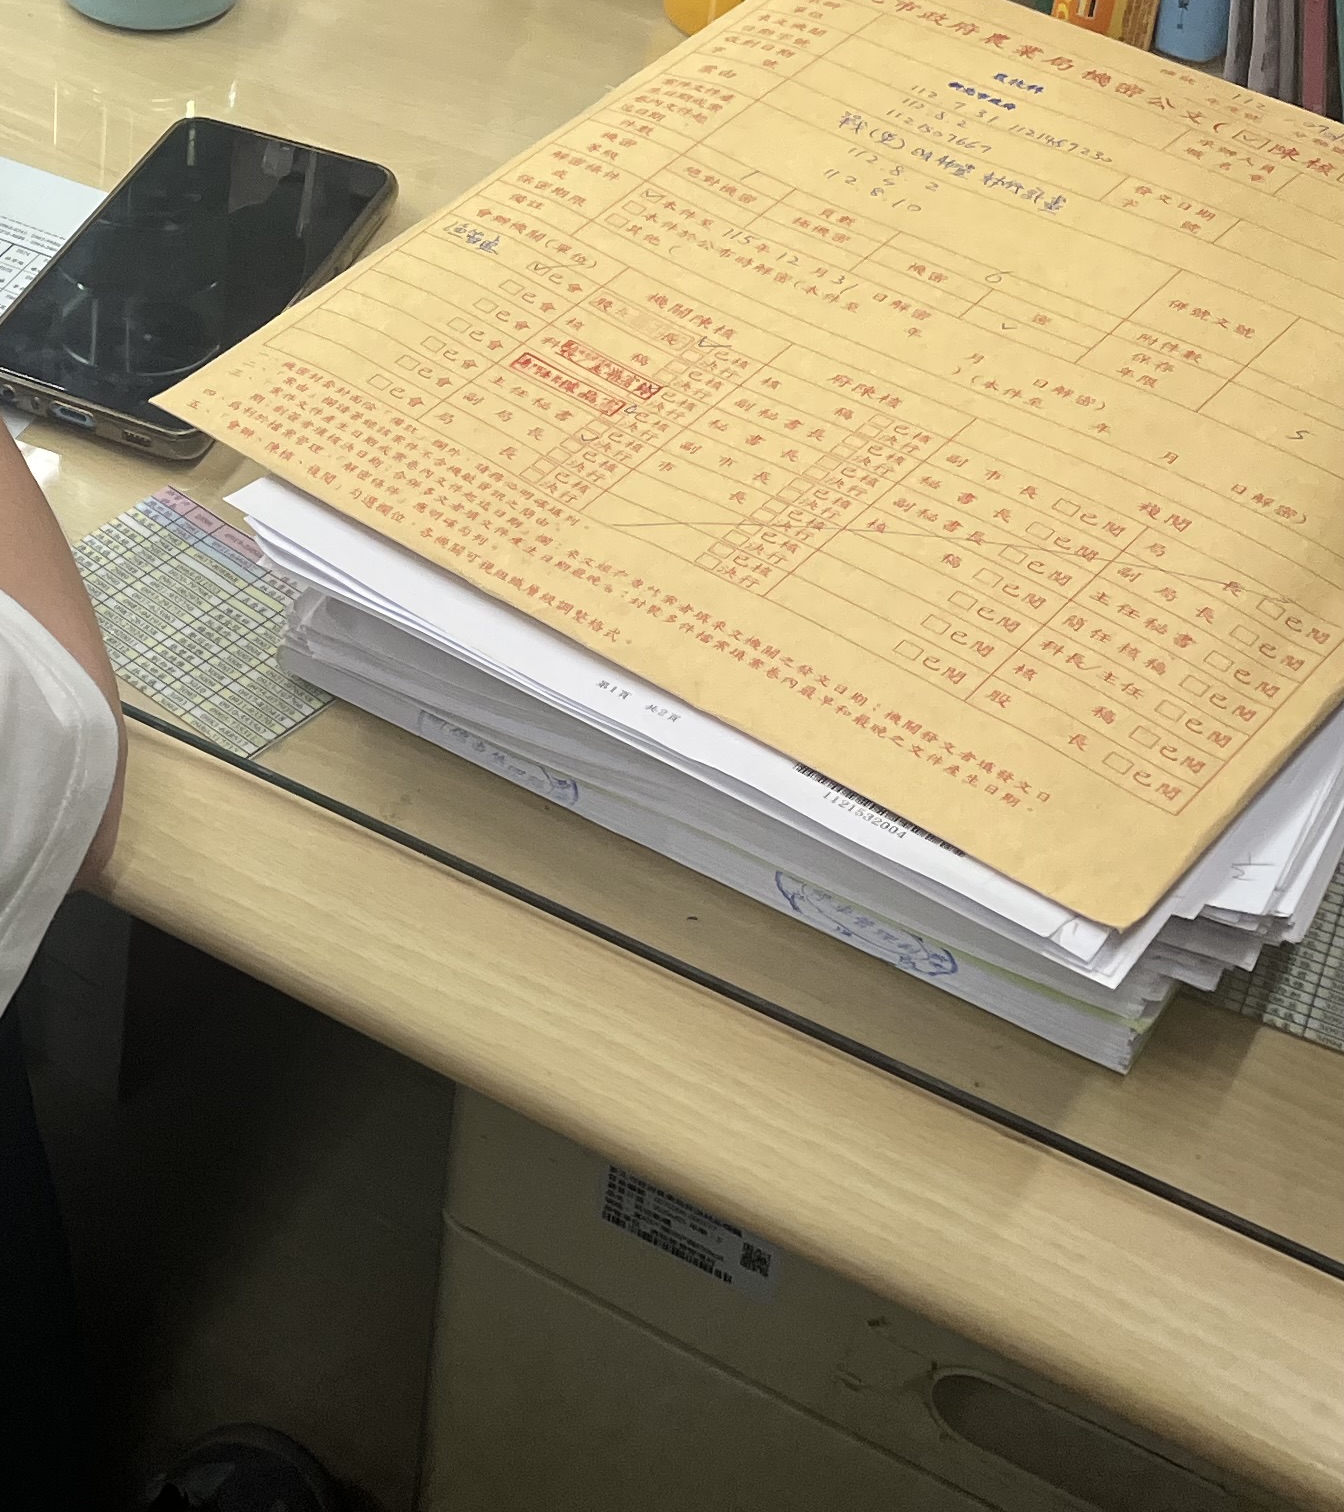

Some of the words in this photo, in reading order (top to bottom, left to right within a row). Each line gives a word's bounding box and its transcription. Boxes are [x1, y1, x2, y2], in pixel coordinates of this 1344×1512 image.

[981, 265, 1014, 286] 6
[596, 678, 634, 701] 第1頁
[644, 703, 682, 724] 共2頁
[822, 790, 908, 841] 1121532004
